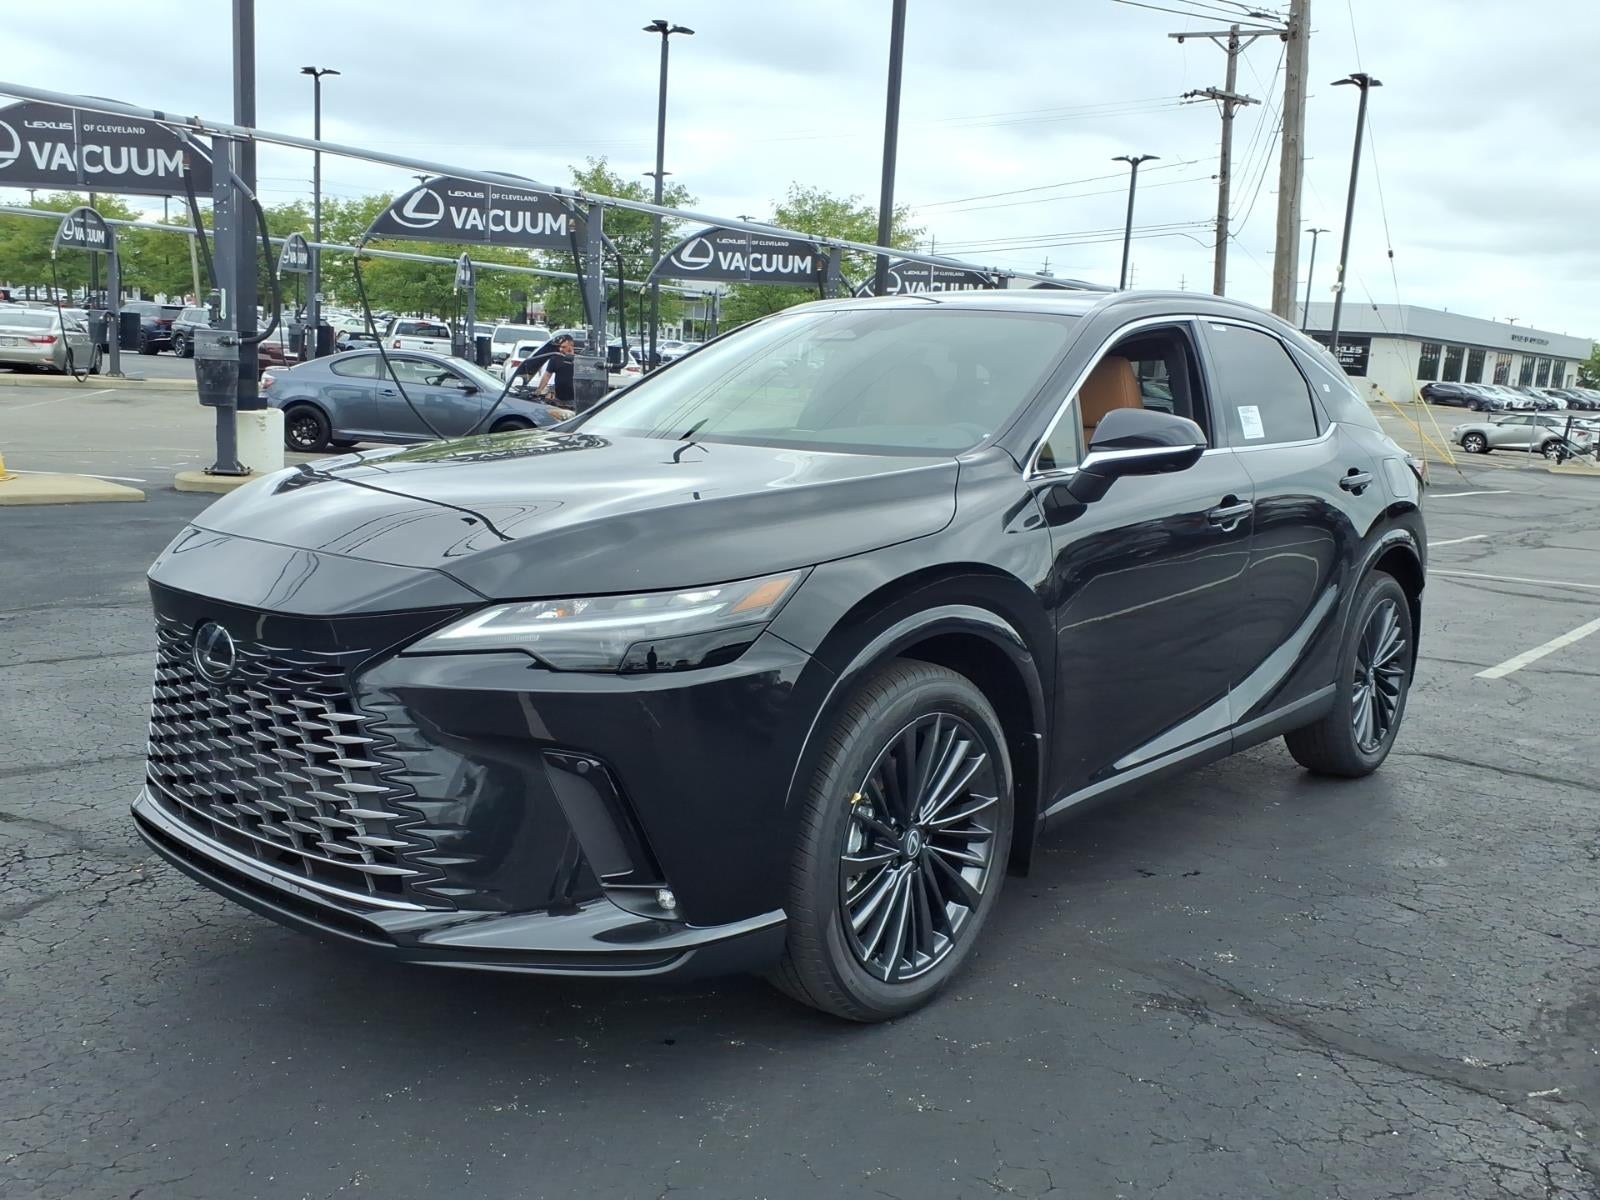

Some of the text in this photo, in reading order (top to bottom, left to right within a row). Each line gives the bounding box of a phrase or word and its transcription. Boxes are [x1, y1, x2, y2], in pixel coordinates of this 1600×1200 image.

[24, 120, 73, 130] LEXUS
[96, 125, 145, 134] CLEVELAND
[28, 141, 184, 177] VACUUM
[448, 190, 484, 198] LEXUS
[501, 193, 538, 202] CLEVELAND
[449, 206, 567, 236] VACUUM
[718, 251, 812, 274] VACUUM
